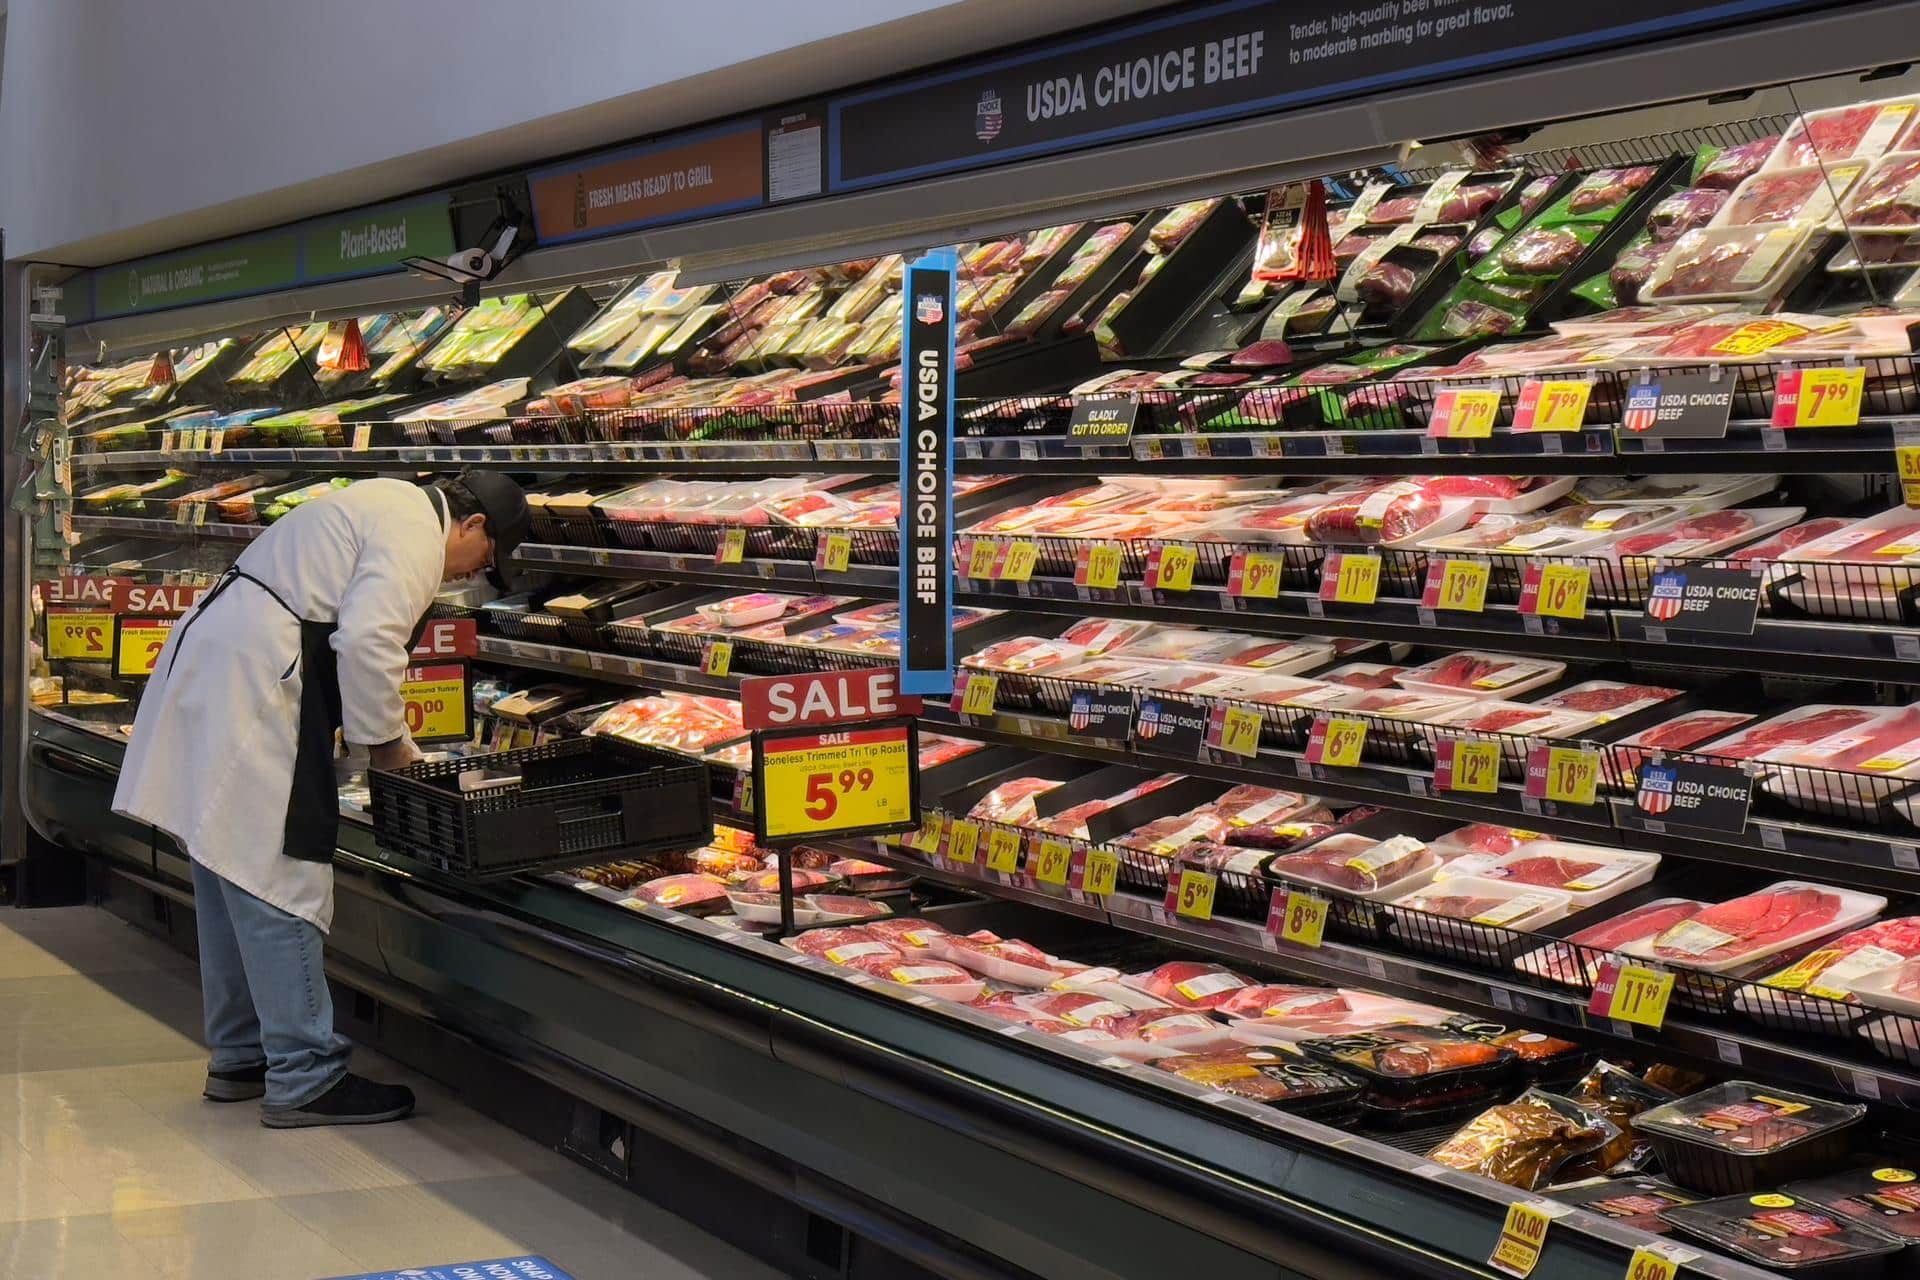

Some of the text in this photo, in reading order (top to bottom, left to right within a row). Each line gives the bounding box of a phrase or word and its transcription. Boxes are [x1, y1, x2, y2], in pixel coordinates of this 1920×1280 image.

[1290, 22, 1329, 41] Tender,
[1331, 2, 1400, 33] high-quality
[1289, 4, 1514, 64] to moderate marbling for great flavor.
[1026, 31, 1264, 121] USDA CHOICE BEEF
[589, 164, 713, 208] FRESH MEATS READY TO GRILL
[340, 218, 407, 260] Plant-Based
[174, 265, 204, 290] ORGANIC
[1660, 393, 1728, 406] USDA CHOICE
[1777, 394, 1798, 405] SALE
[1088, 410, 1118, 421] GLADLY
[1657, 409, 1683, 420] BEEF
[1072, 423, 1128, 435] CUT TO ORDER
[917, 351, 939, 604] USDA CHOICE BEEF
[1523, 583, 1539, 593] SALE
[1686, 585, 1757, 600] USDA CHOICE
[1683, 600, 1710, 611] BEEF
[768, 674, 897, 723] SALE
[1160, 713, 1202, 730] USDA CHOICE
[819, 733, 850, 746] SALE
[763, 743, 906, 766] Boneless Trimmed Tri Tip Roast
[1530, 767, 1547, 777] SALE
[1676, 781, 1747, 801] USDA CHOICE
[877, 798, 888, 807] LB
[1674, 796, 1701, 808] BEEF
[1596, 982, 1614, 994] SALE
[1511, 1209, 1545, 1240] 10.00
